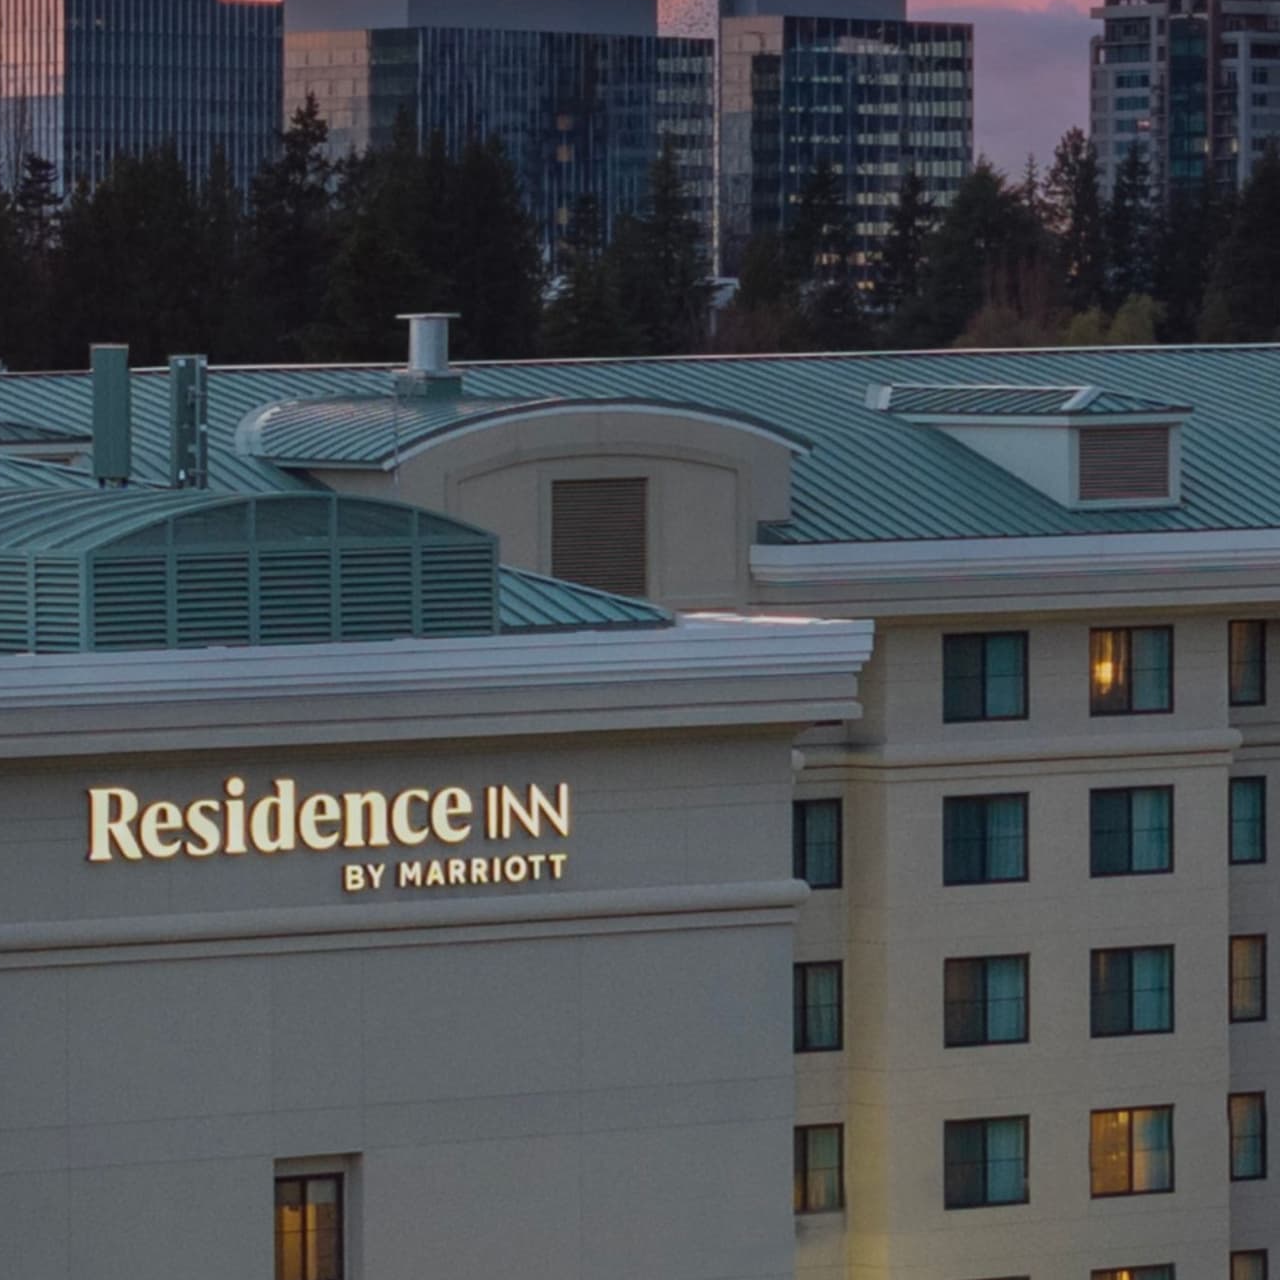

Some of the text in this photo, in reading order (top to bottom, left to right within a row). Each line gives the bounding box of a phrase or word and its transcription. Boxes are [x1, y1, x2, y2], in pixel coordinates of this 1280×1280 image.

[88, 776, 569, 862] Residence INN
[344, 853, 568, 891] BY MARRIOTT
